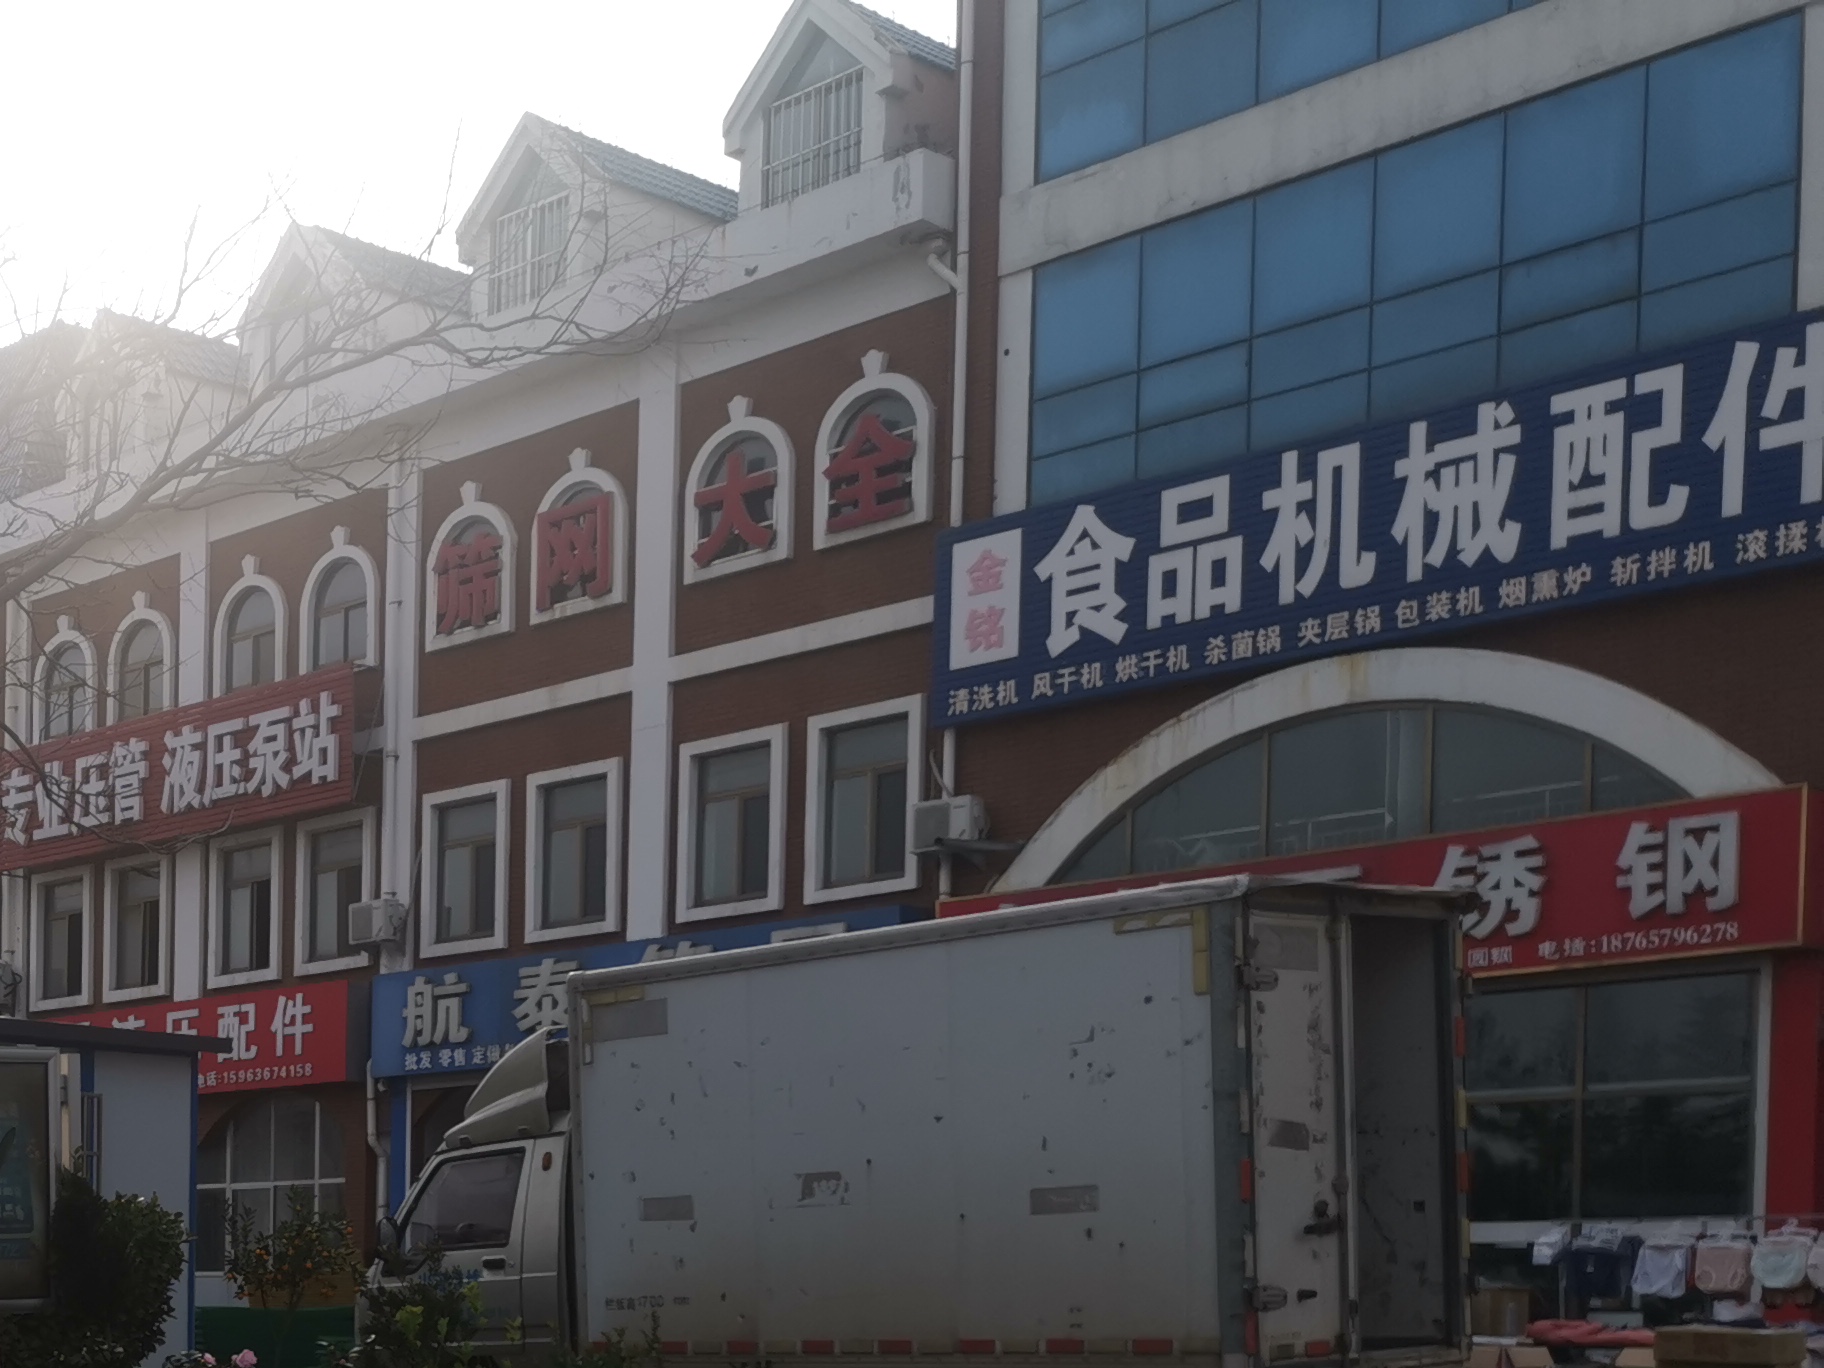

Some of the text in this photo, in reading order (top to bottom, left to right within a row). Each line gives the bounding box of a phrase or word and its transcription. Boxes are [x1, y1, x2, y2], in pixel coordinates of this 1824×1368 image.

[432, 413, 916, 636] 筛网大全
[1033, 340, 1824, 660] 食品机械配件
[947, 678, 1019, 717] 清洗机
[1030, 662, 1104, 700] 风干机
[1114, 643, 1191, 685] 烘干机
[1203, 625, 1283, 665] 杀菌锅
[1296, 602, 1383, 648] 夹层锅
[1394, 584, 1486, 630] 包装机
[1497, 562, 1594, 610] 烟熏炉
[1733, 517, 1824, 566] 滚揉
[965, 547, 1010, 653] 金铭
[1, 690, 343, 847] 专业压管 液压泵站
[1276, 811, 1741, 940] 锈钢
